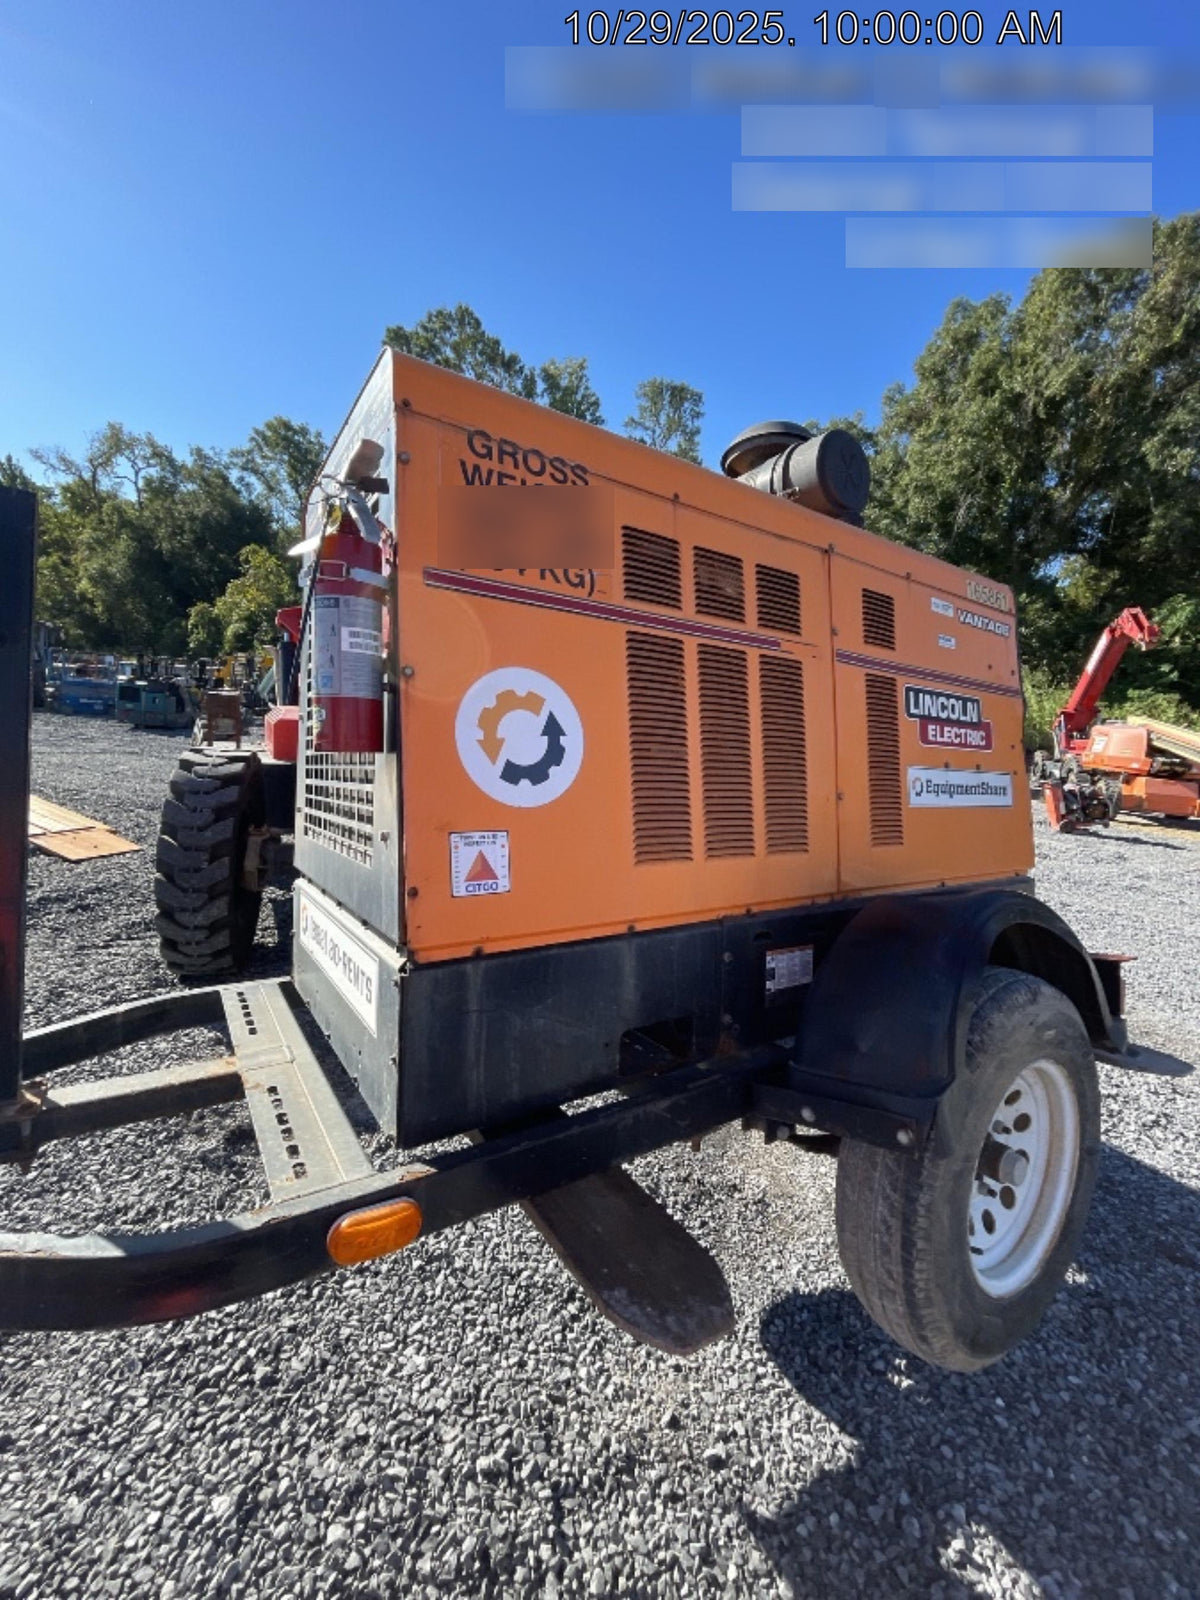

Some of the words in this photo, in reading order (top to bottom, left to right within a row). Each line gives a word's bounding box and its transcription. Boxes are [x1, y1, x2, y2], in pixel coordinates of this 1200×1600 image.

[466, 429, 590, 486] GROSS
[958, 607, 1010, 638] VANTAGE
[909, 690, 980, 723] LINCOLN
[927, 724, 986, 746] ELECTRIC
[925, 779, 1008, 798] EquipmentShare
[465, 881, 499, 893] CITGO
